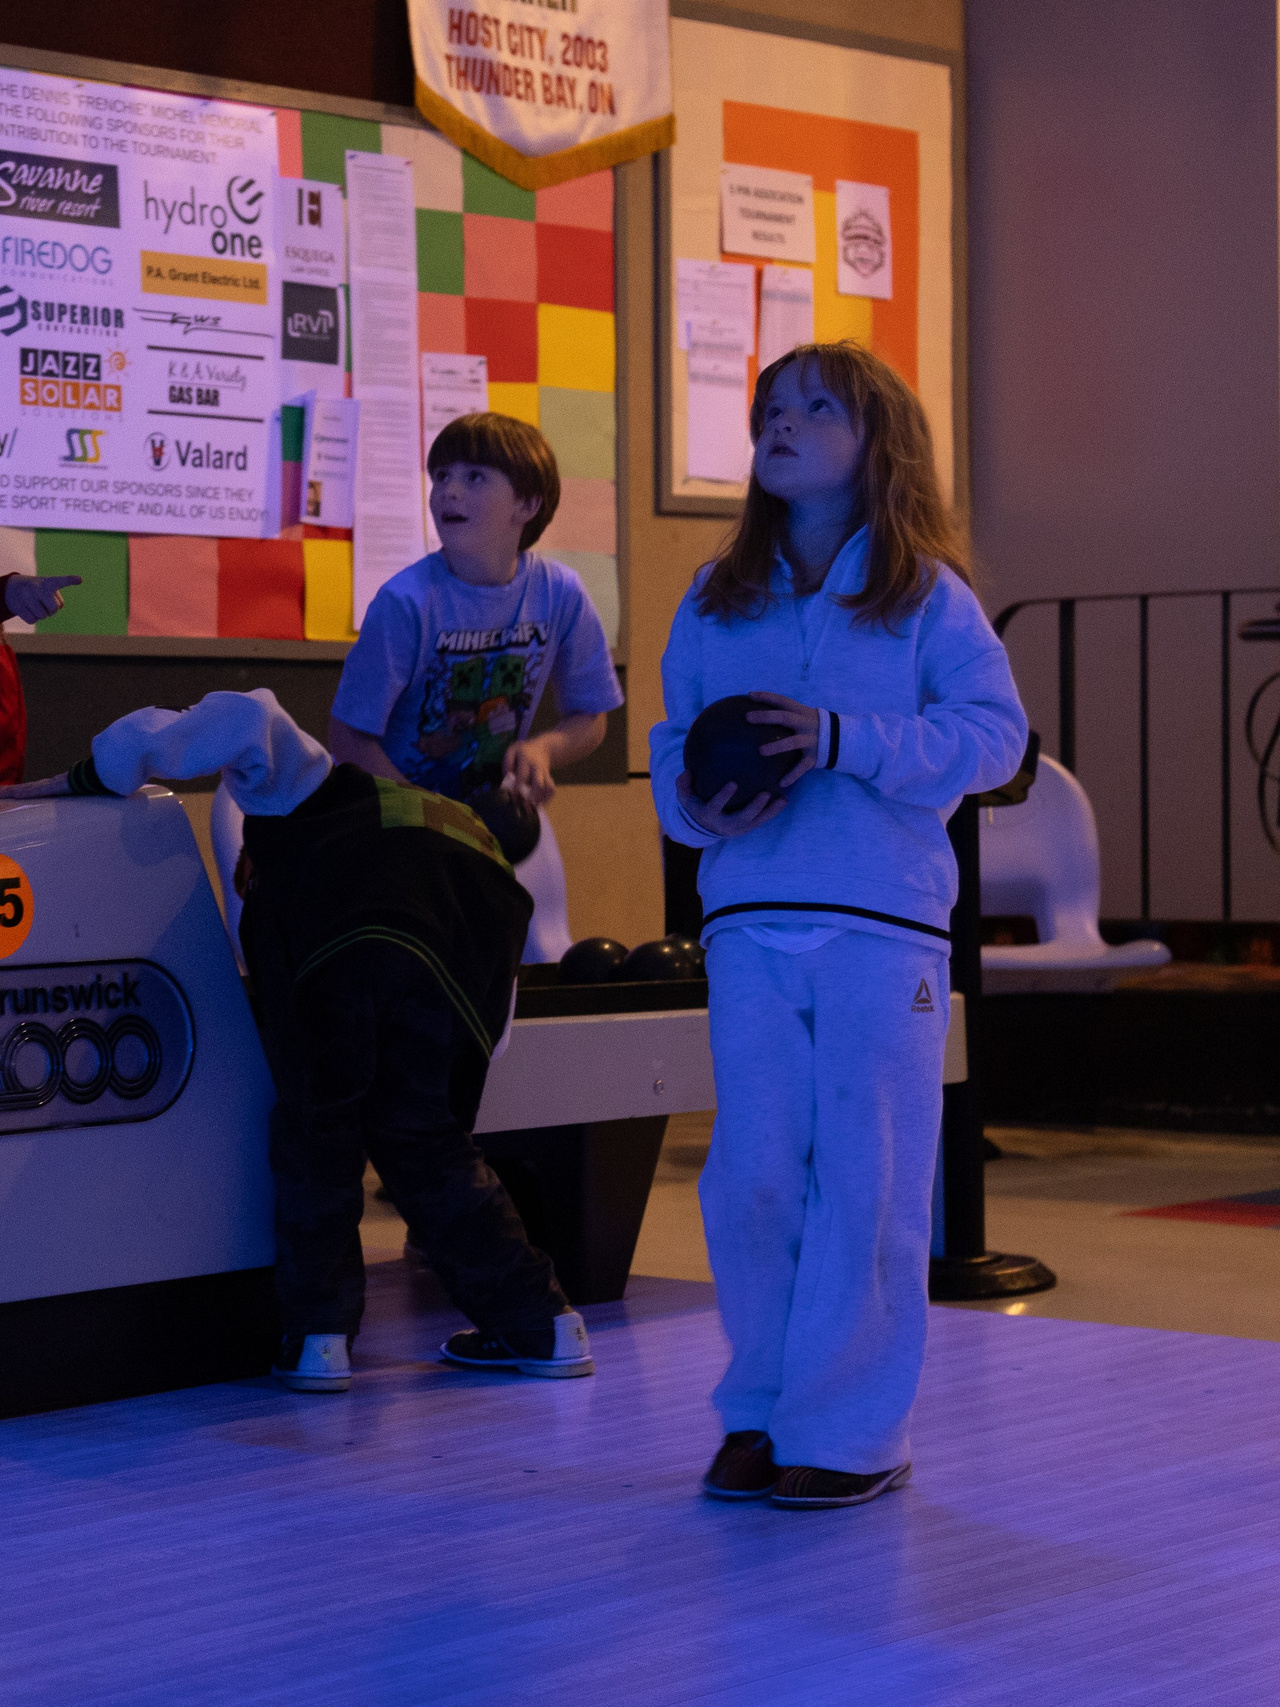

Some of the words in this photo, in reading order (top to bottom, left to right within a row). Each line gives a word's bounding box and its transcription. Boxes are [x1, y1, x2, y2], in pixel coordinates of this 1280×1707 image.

[447, 7, 501, 50] HOST
[506, 22, 554, 67] CITY,
[561, 33, 609, 73] 2003
[445, 53, 537, 104] THUNDER
[542, 72, 584, 112] BAY,
[588, 80, 616, 116] ON
[22, 85, 69, 106] DENNIS
[151, 105, 196, 124] MICHEL
[199, 113, 263, 134] MEMORIAL
[27, 106, 102, 131] FOLLOWING
[106, 117, 176, 140] SPONSORS
[180, 128, 206, 144] FOR
[209, 131, 245, 149] THEIR
[81, 134, 98, 149] TO
[102, 136, 128, 152] THE
[132, 140, 217, 164] TOURNAMENT
[18, 191, 52, 214] river
[55, 197, 102, 218] resort
[143, 179, 227, 234] hydro
[1, 236, 112, 274] FIREDOG
[211, 230, 262, 259] one
[168, 268, 199, 282] Grant
[201, 271, 241, 287] Electric
[30, 300, 125, 329] SUPERIOR
[21, 349, 101, 380] JAZZ
[21, 379, 122, 411] SOLAR
[168, 384, 193, 405] GAS
[196, 387, 220, 407] BAR
[22, 408, 124, 422] SOLUTIONS
[175, 439, 248, 472] Valard
[14, 475, 76, 492] SUPPORT
[80, 479, 108, 493] OUR
[112, 480, 182, 498] SPONSORS
[185, 484, 220, 501] SINCE
[223, 486, 254, 502] THEY
[11, 494, 56, 510] SPORT
[137, 502, 163, 516] AND
[166, 503, 187, 518] ALL
[189, 505, 206, 519] OF
[209, 506, 225, 521] US
